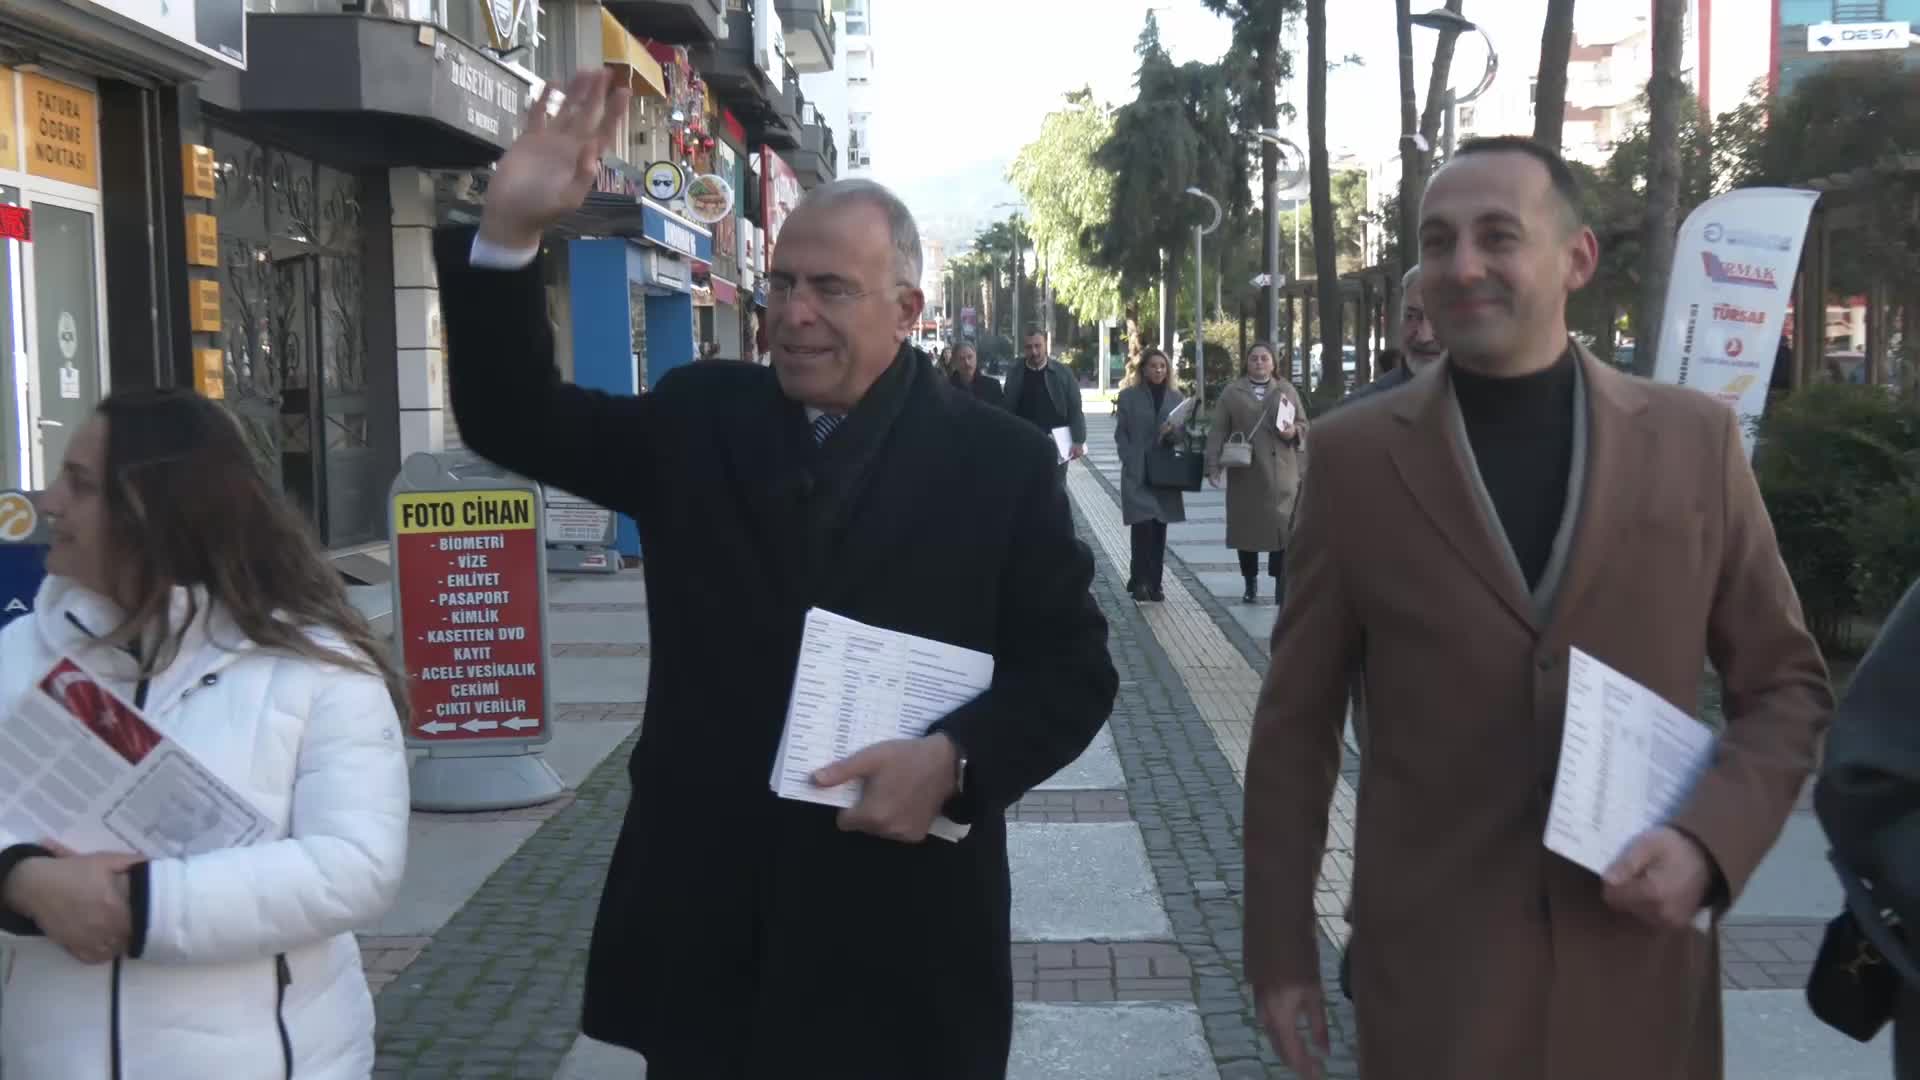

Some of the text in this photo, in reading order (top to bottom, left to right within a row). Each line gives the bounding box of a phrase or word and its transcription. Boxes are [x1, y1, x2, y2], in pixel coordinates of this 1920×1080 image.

[1841, 28, 1897, 41] DESA
[36, 91, 81, 120] FATURA
[39, 111, 81, 145] ÖDEME
[35, 143, 86, 170] NOKTASI
[402, 502, 455, 528] FOTO
[463, 496, 529, 526] CİHAN
[439, 534, 504, 550] BİOMETRİ
[457, 553, 488, 568] VİZE
[447, 571, 500, 587] EHLİYET
[439, 591, 510, 606] PASAPORT
[451, 608, 499, 624] KİMLİK
[427, 627, 525, 643] KASETTEN DVD
[453, 647, 491, 660] KAYIT
[421, 662, 537, 680] ACELE VESİKALIK
[451, 680, 499, 698] ÇEKİMİ
[436, 697, 526, 717] ÇIKTI VERİLİR
